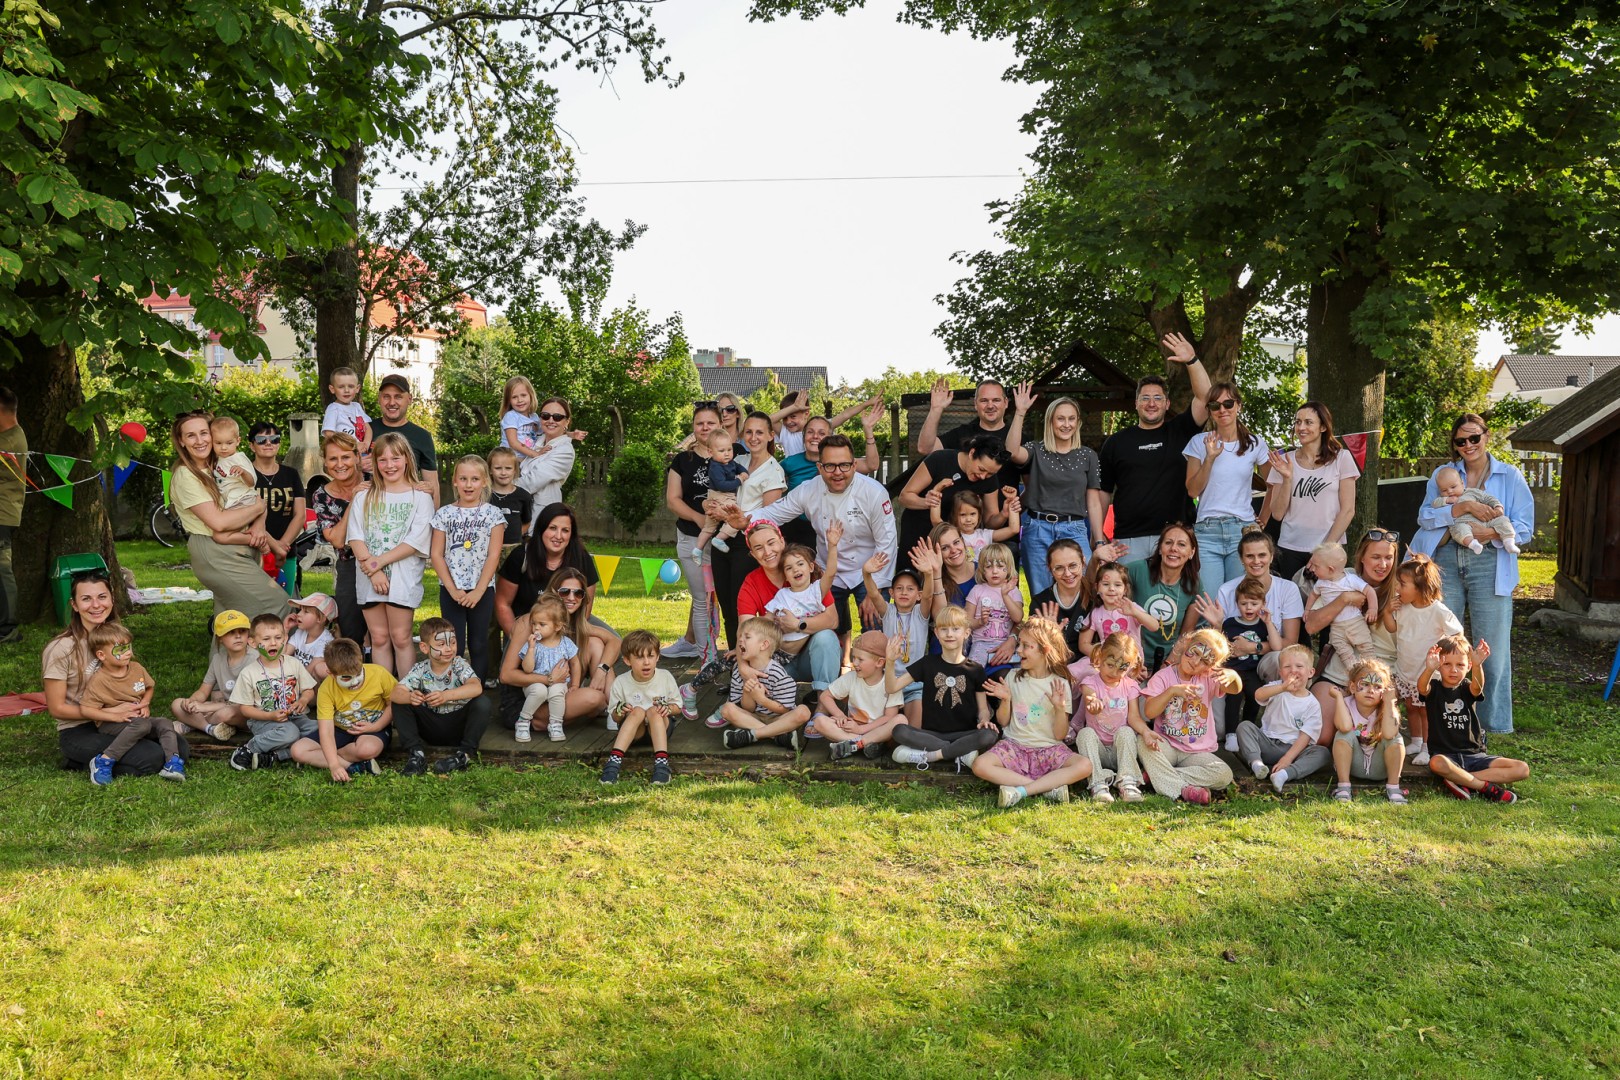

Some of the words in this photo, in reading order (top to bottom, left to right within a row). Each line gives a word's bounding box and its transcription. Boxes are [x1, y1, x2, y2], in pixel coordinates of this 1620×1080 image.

[447, 517, 487, 533] Weekend
[1443, 713, 1468, 722] SUPER
[1447, 721, 1465, 730] SYN
